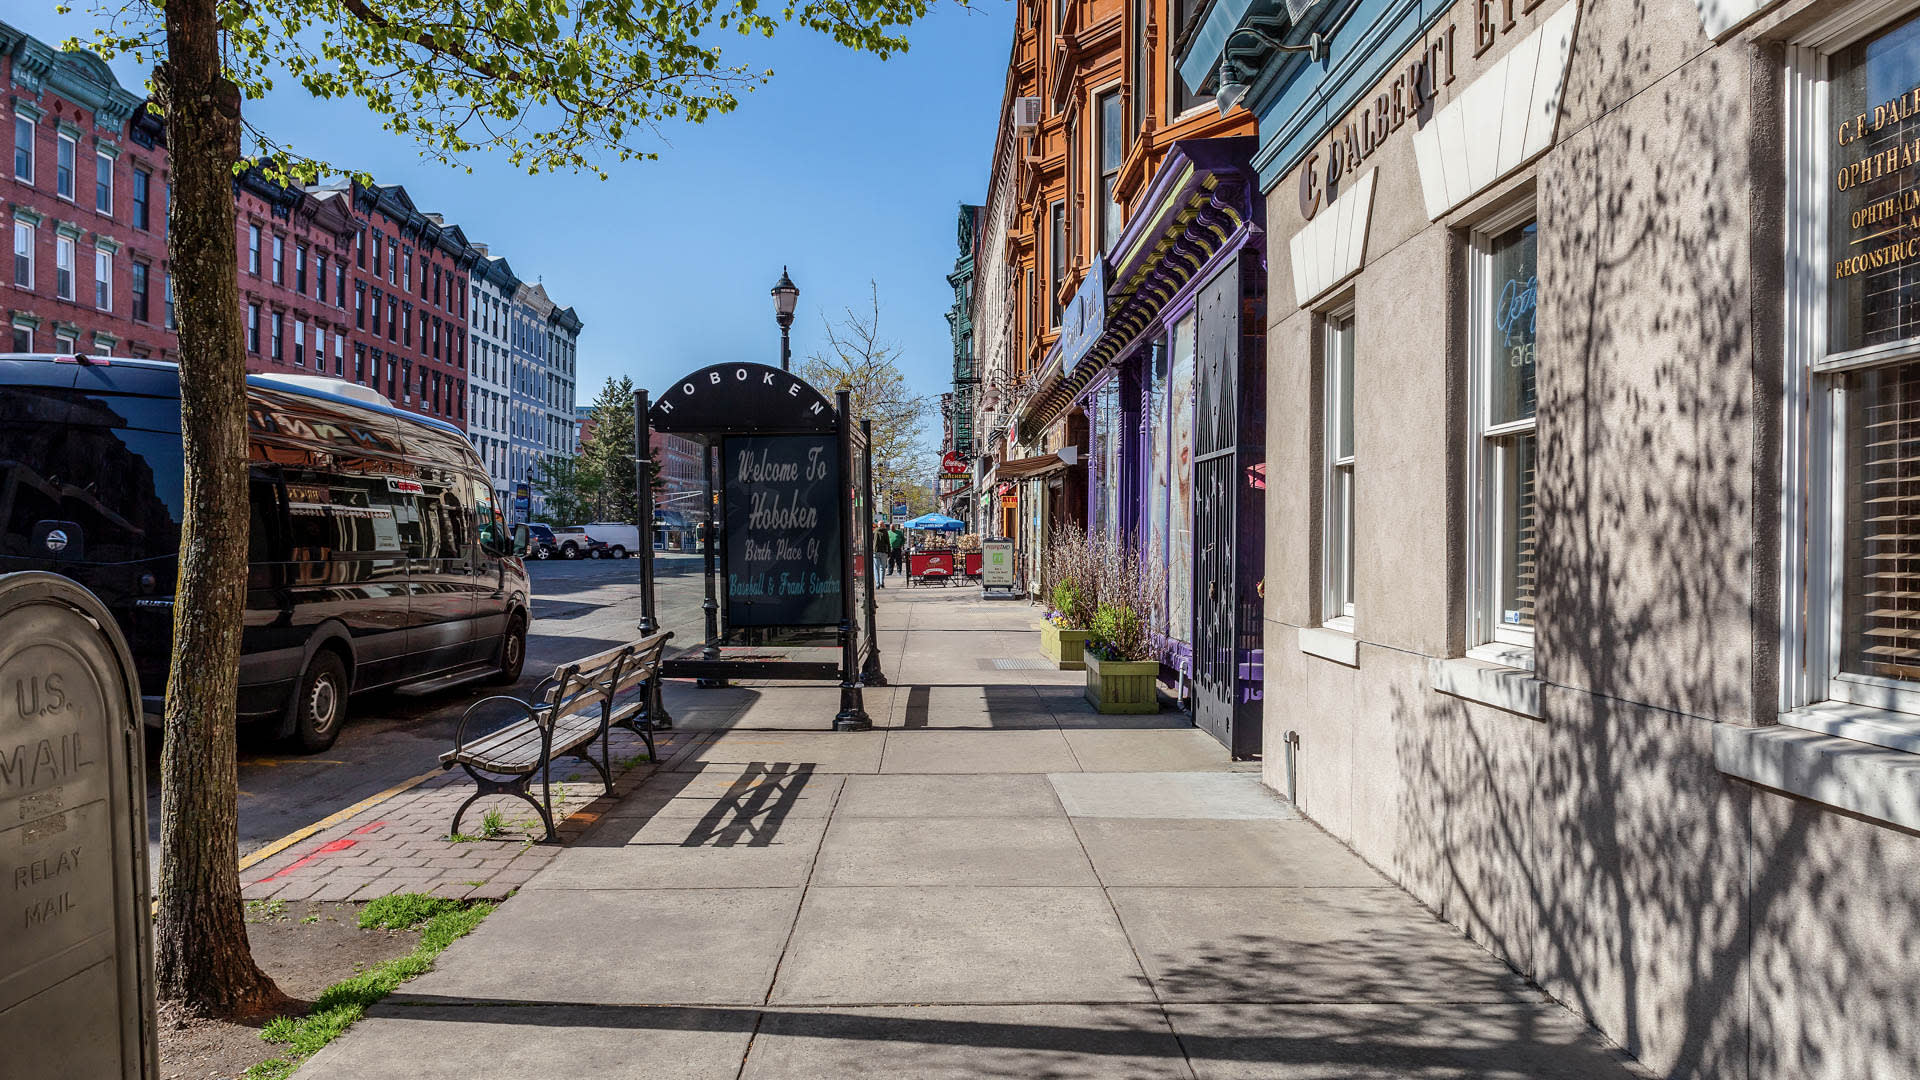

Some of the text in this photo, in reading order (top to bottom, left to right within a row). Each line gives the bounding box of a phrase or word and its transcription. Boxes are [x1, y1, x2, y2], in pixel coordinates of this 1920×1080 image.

[1328, 23, 1456, 187] D'ALBERTI
[1910, 214, 1920, 230] A
[1836, 236, 1920, 280] RECONSTRUC
[659, 368, 824, 415] HOBOKEN
[739, 446, 827, 482] Welcome To
[749, 489, 817, 530] Hoboken
[745, 537, 820, 565] Birth Place Of
[729, 573, 765, 596] Baseball
[768, 576, 775, 596] &
[779, 571, 805, 596] Frank
[16, 673, 73, 720] U.S.
[0, 732, 95, 788] MAIL
[15, 846, 82, 891] RELAY
[25, 891, 76, 930] MAIL
